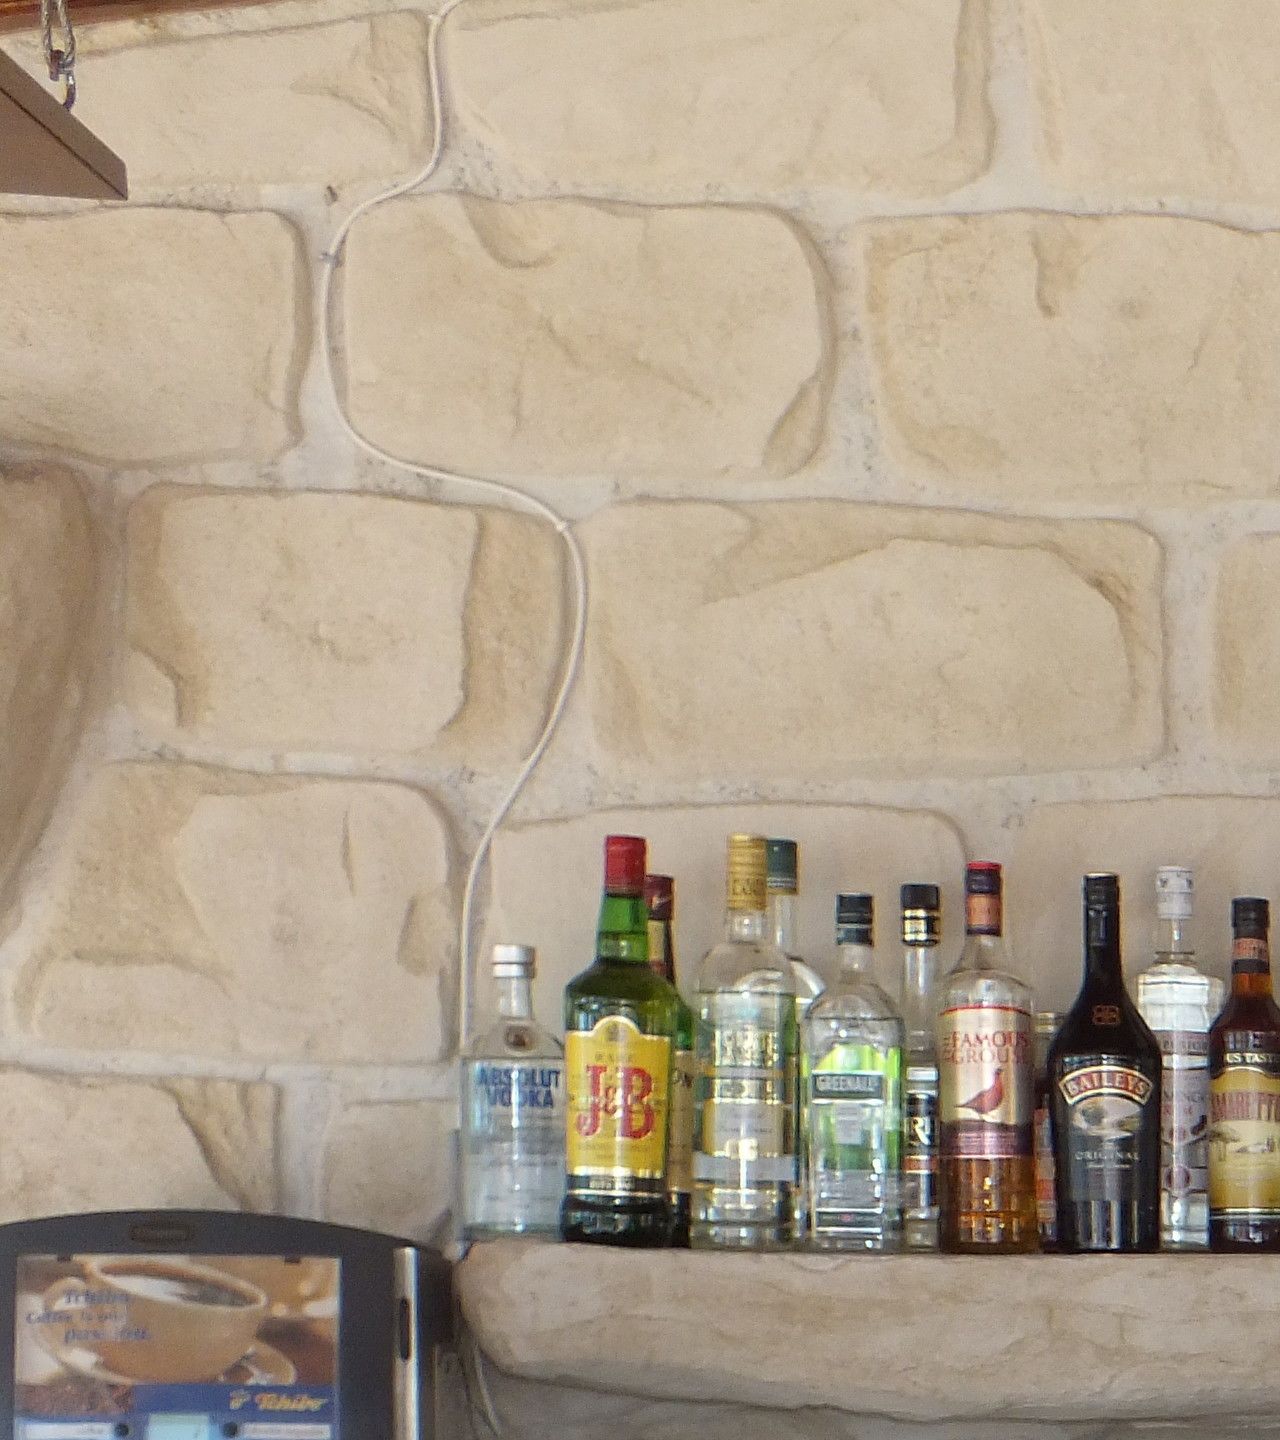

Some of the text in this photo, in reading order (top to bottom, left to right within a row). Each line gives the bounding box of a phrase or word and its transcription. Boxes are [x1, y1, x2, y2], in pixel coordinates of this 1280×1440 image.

[950, 1029, 1029, 1048] FAMOUS
[477, 1066, 561, 1088] ABSOLUT
[1064, 1071, 1149, 1096] BAILEYS
[486, 1085, 555, 1108] VODKA
